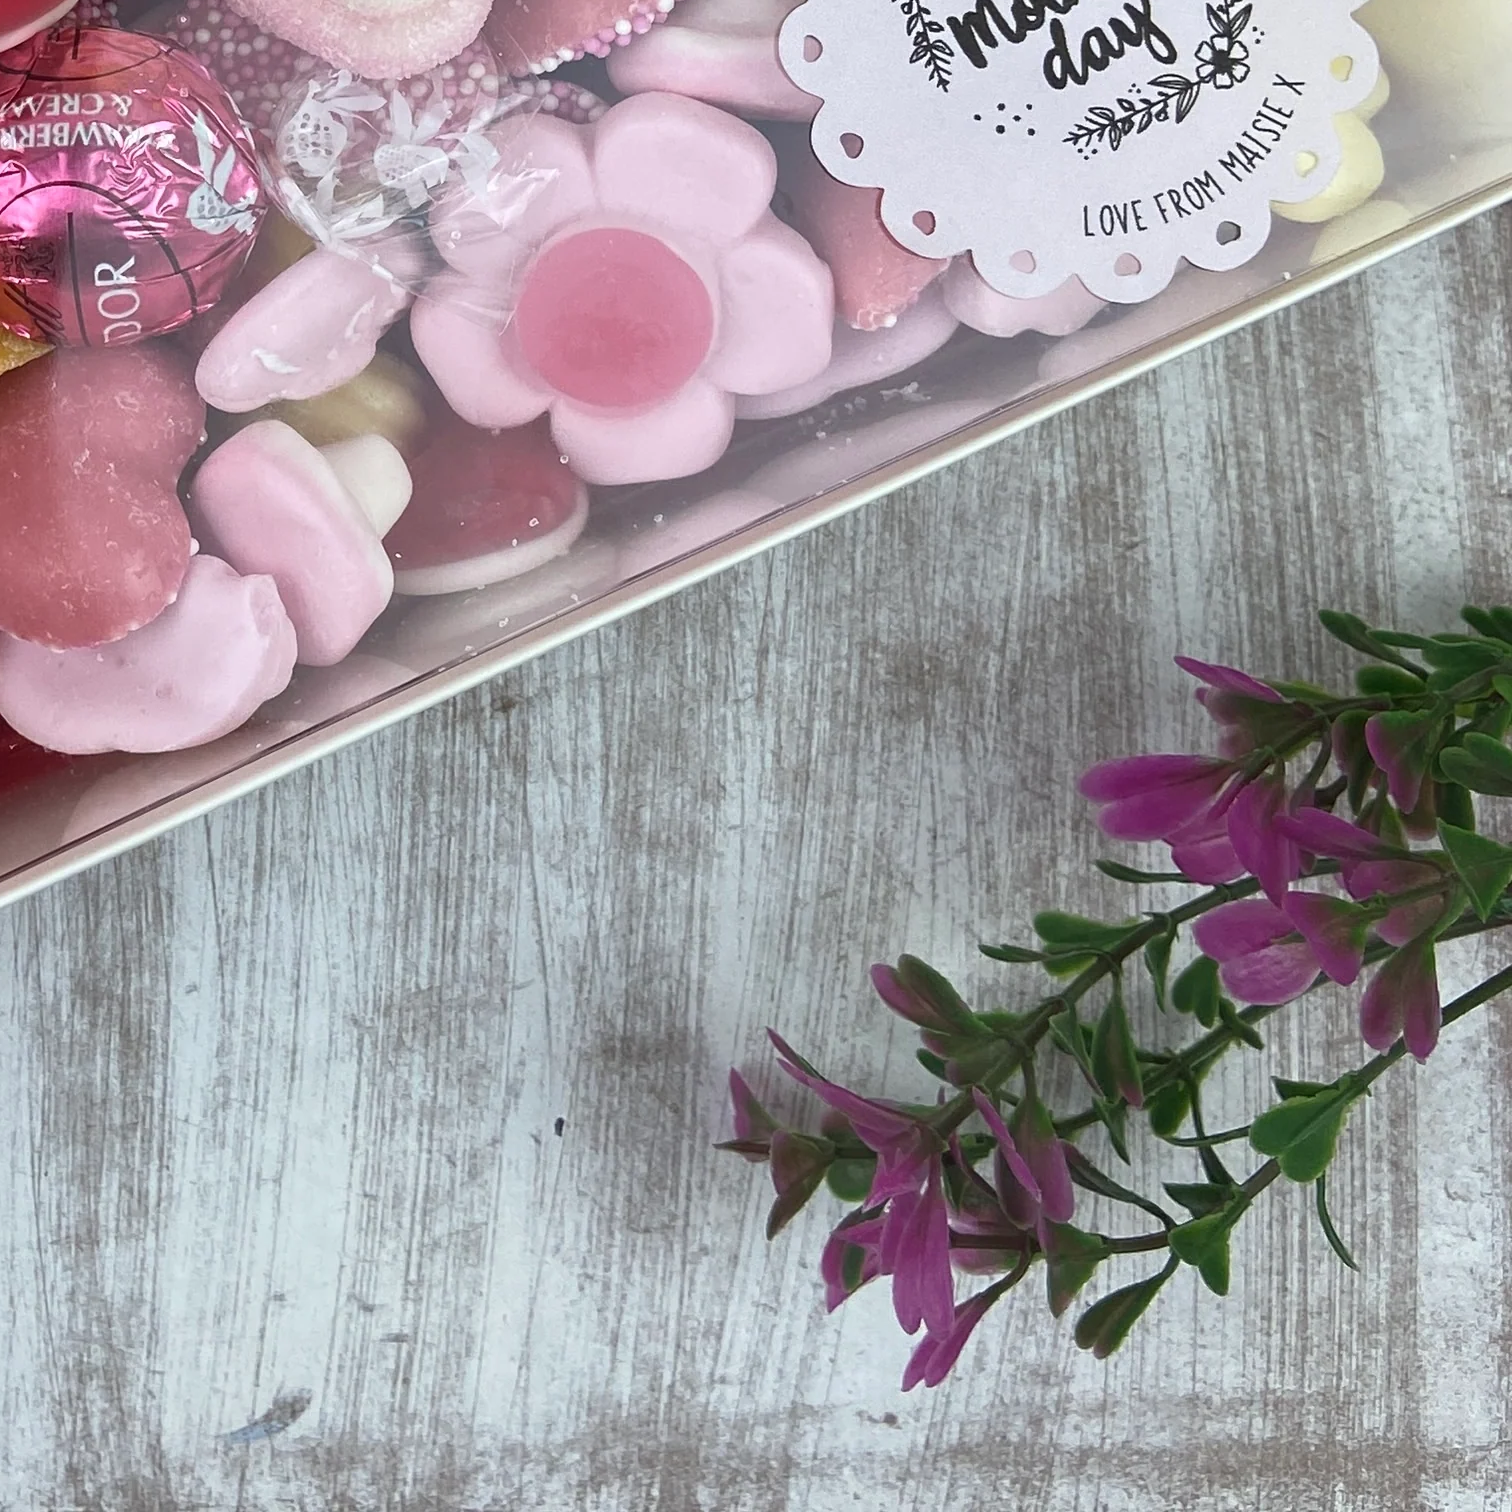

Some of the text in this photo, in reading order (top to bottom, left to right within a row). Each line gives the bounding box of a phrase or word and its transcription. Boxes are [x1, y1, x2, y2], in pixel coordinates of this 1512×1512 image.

[112, 93, 133, 117] &
[1083, 199, 1148, 237] LOVE
[1153, 170, 1225, 224] FROM
[1218, 97, 1294, 182] MAISIE
